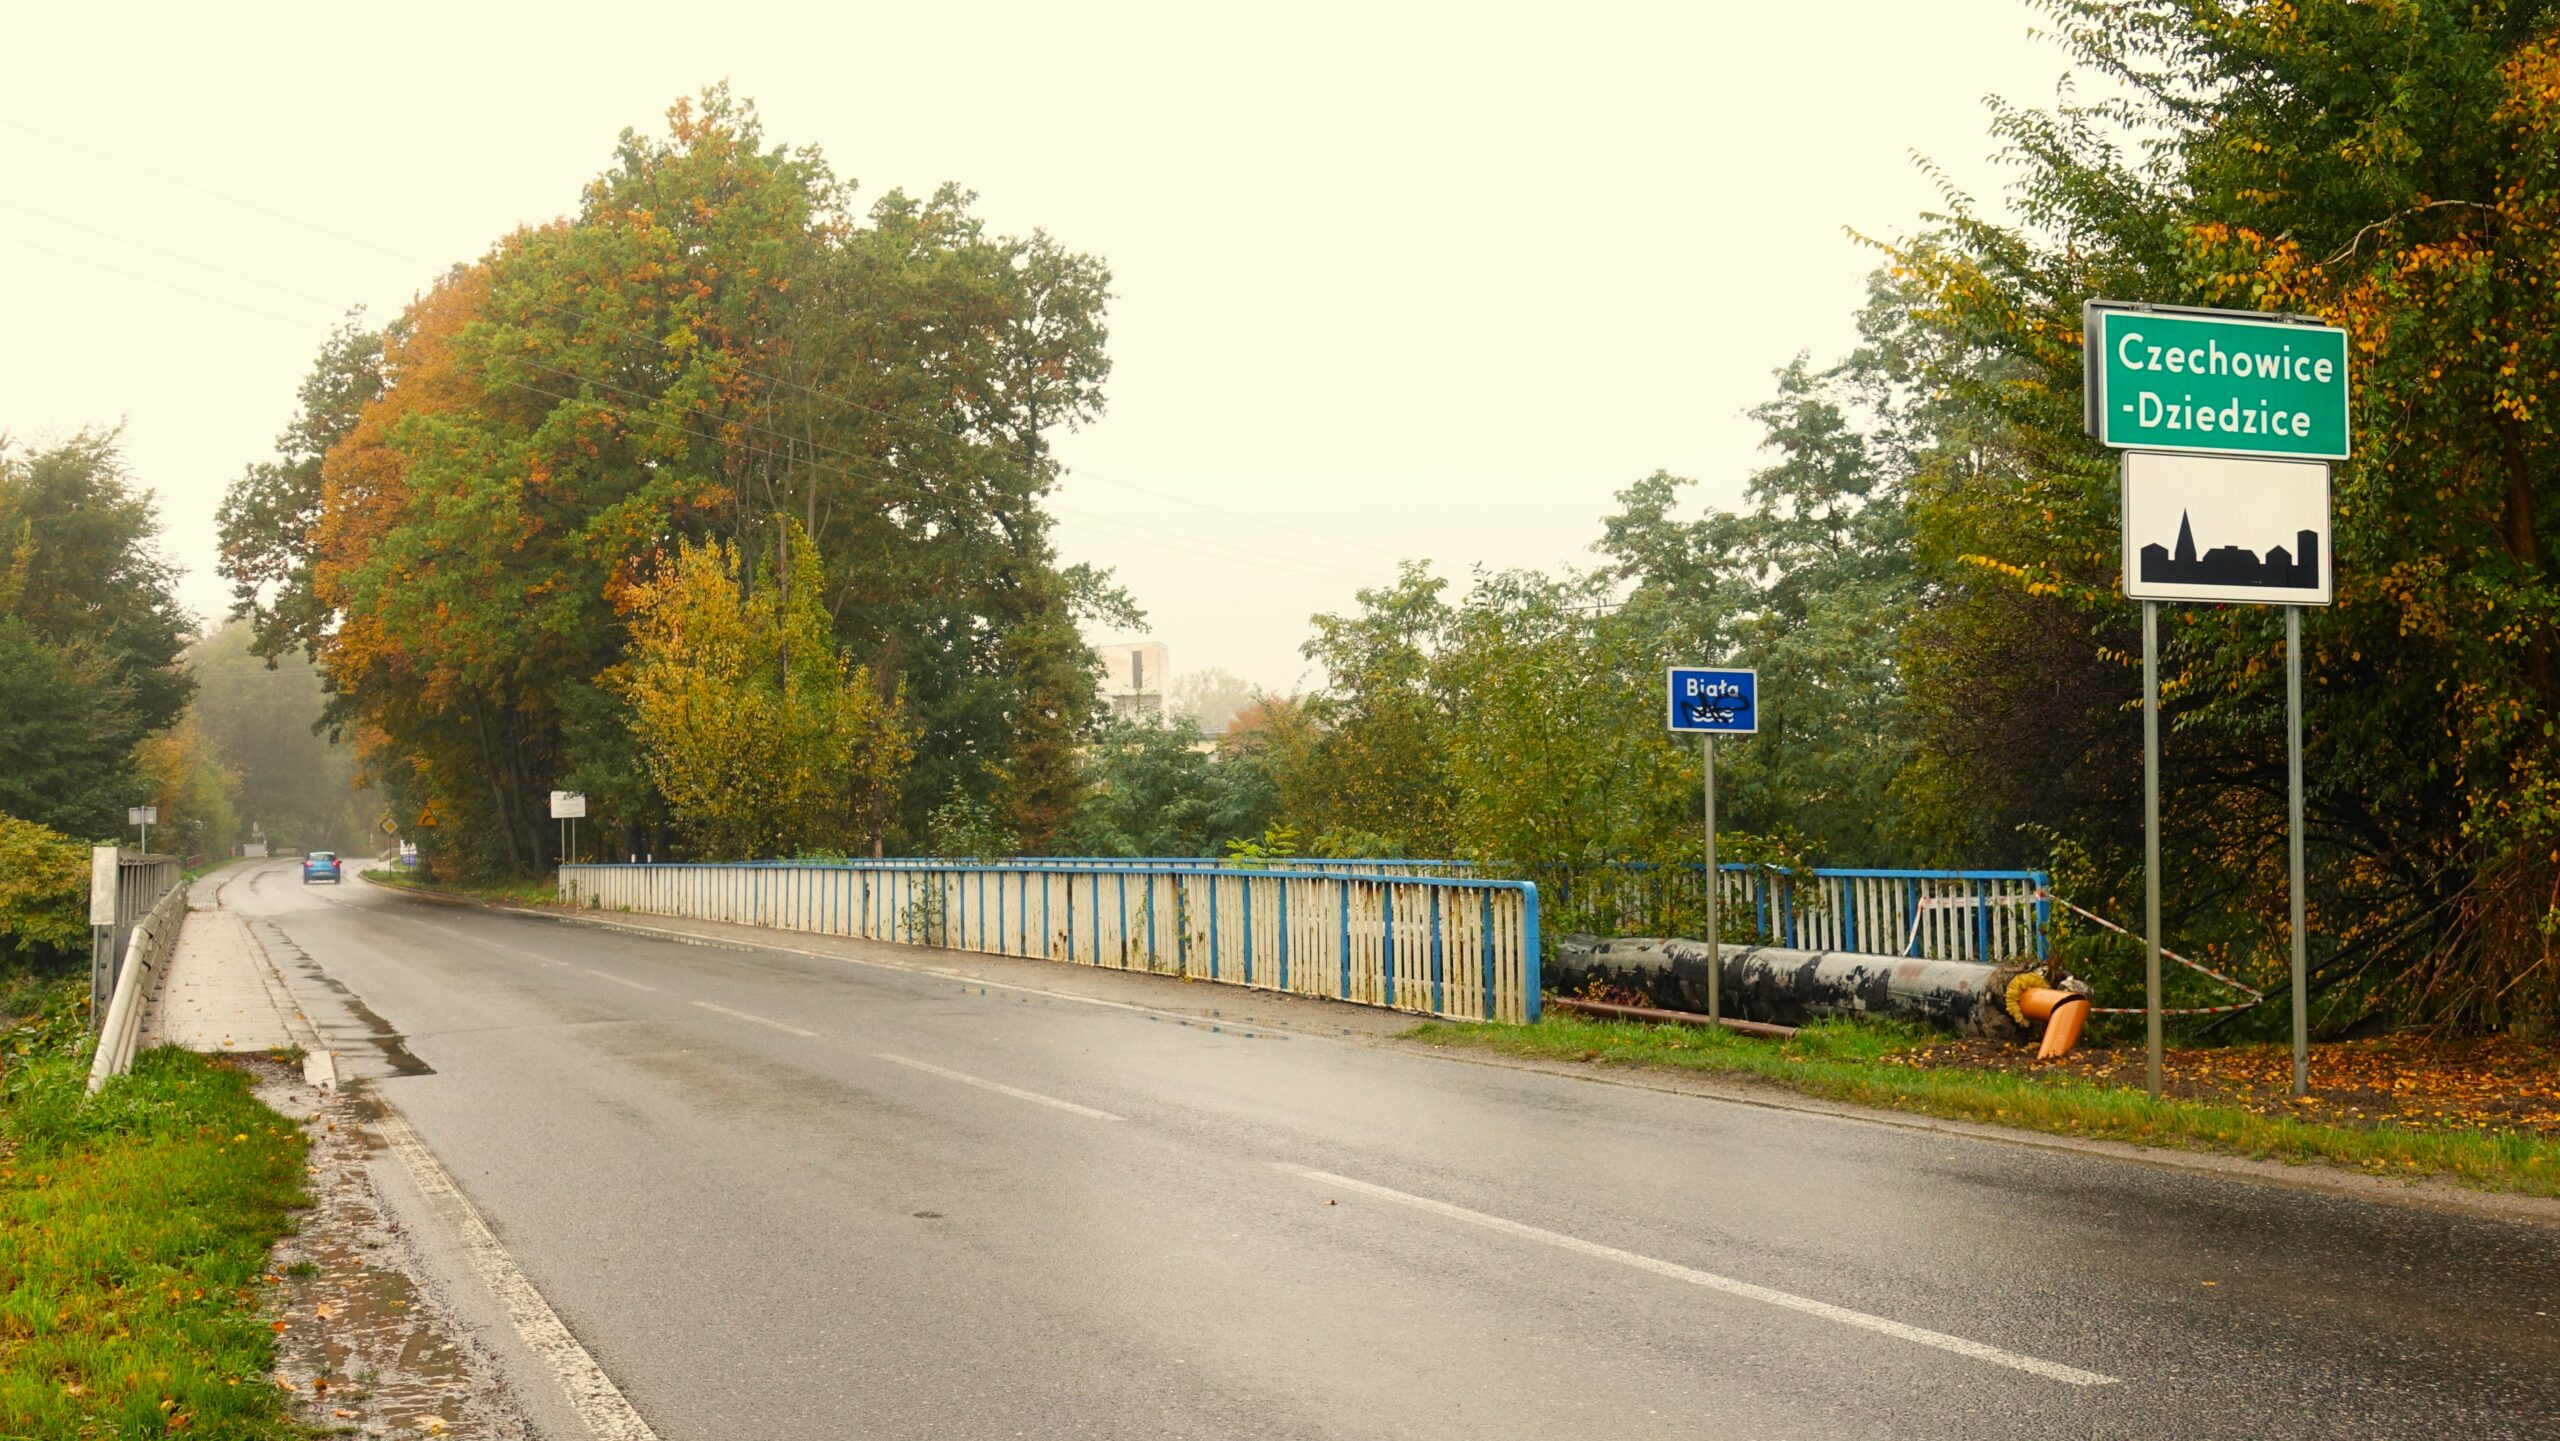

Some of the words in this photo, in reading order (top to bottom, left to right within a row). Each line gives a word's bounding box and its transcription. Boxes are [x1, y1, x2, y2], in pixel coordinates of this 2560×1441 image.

[2118, 332, 2333, 383] Czechowice
[2122, 391, 2311, 437] -Dziedzice
[1686, 678, 1739, 697] Biała
